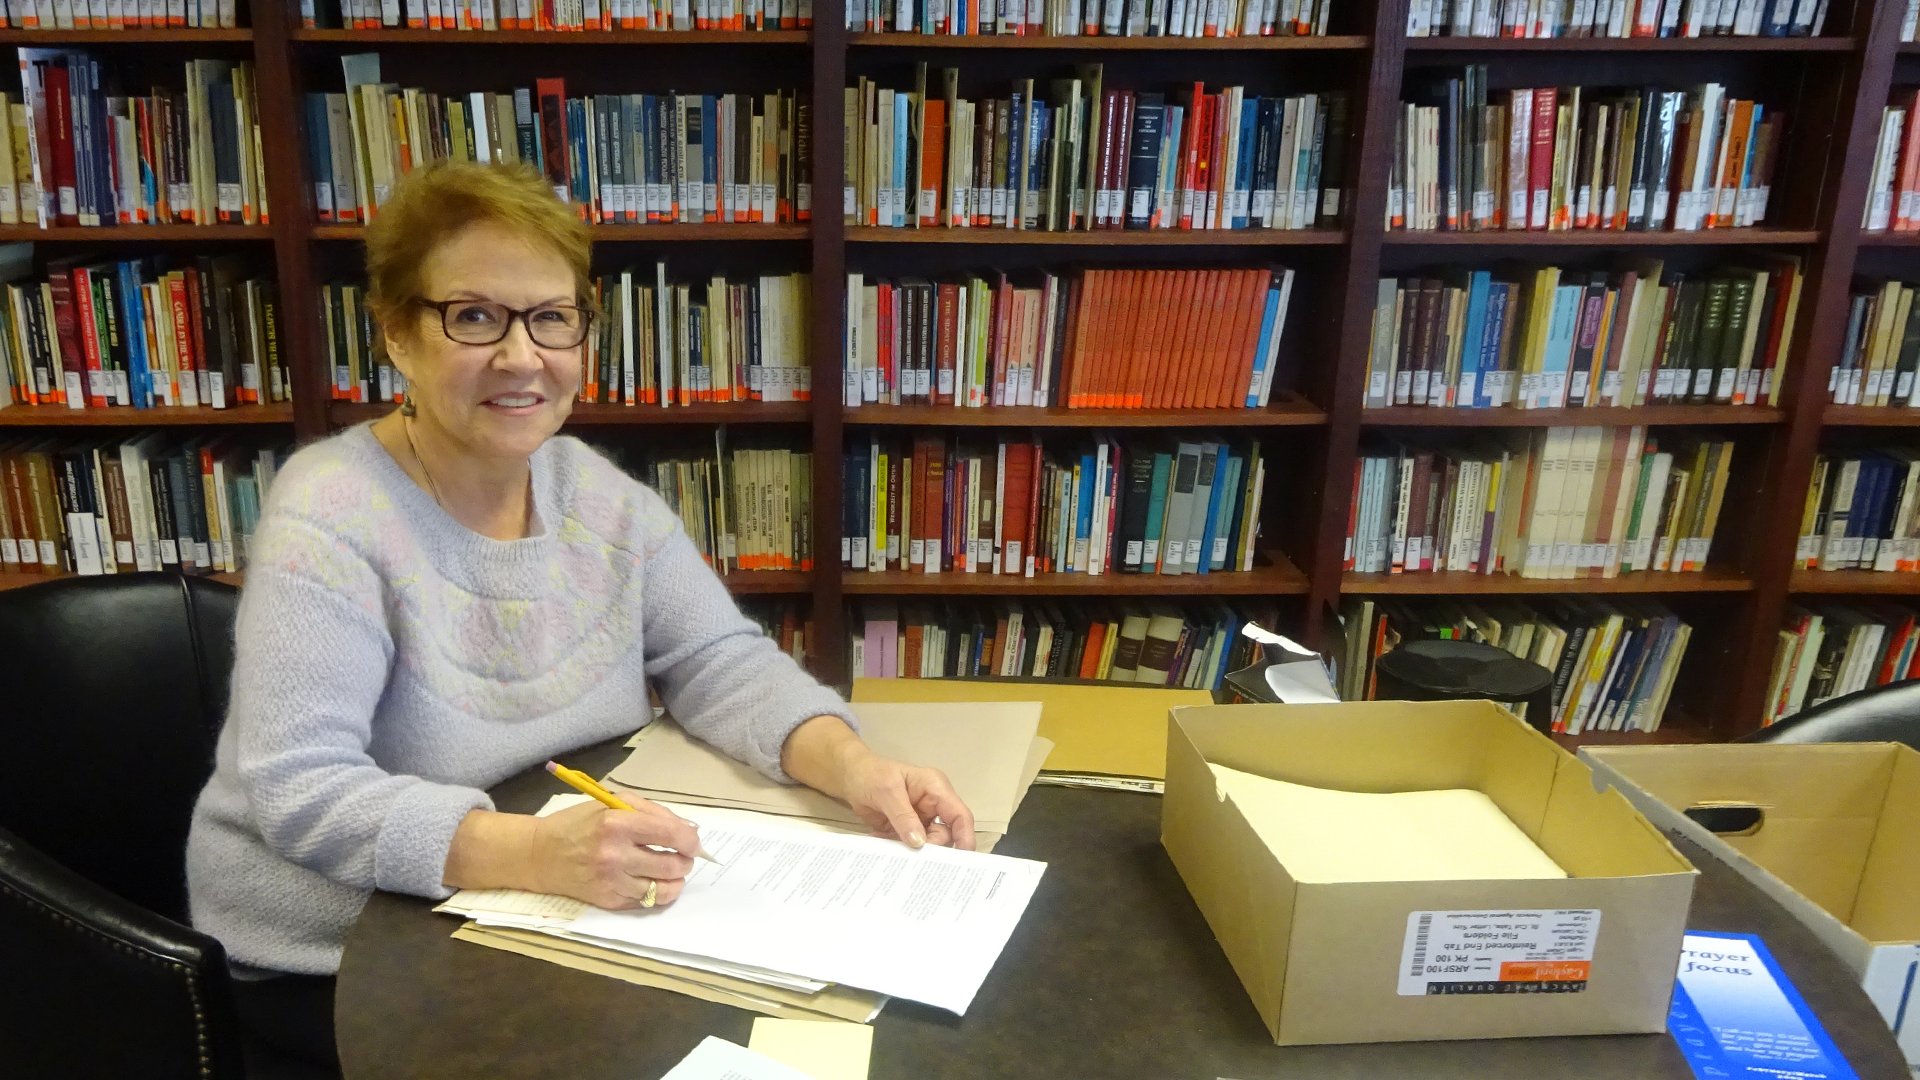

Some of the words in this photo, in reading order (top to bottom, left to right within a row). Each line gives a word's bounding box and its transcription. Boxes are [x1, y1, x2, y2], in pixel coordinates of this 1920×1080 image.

[174, 301, 185, 330] CANDLE
[180, 355, 190, 370] WIN
[127, 475, 139, 499] Soviet
[1681, 950, 1750, 962] rayer
[1426, 965, 1469, 973] ARSF100
[1536, 964, 1584, 980] Gaylord
[1684, 962, 1753, 975] focus
[1428, 984, 1494, 992] QUALITY
